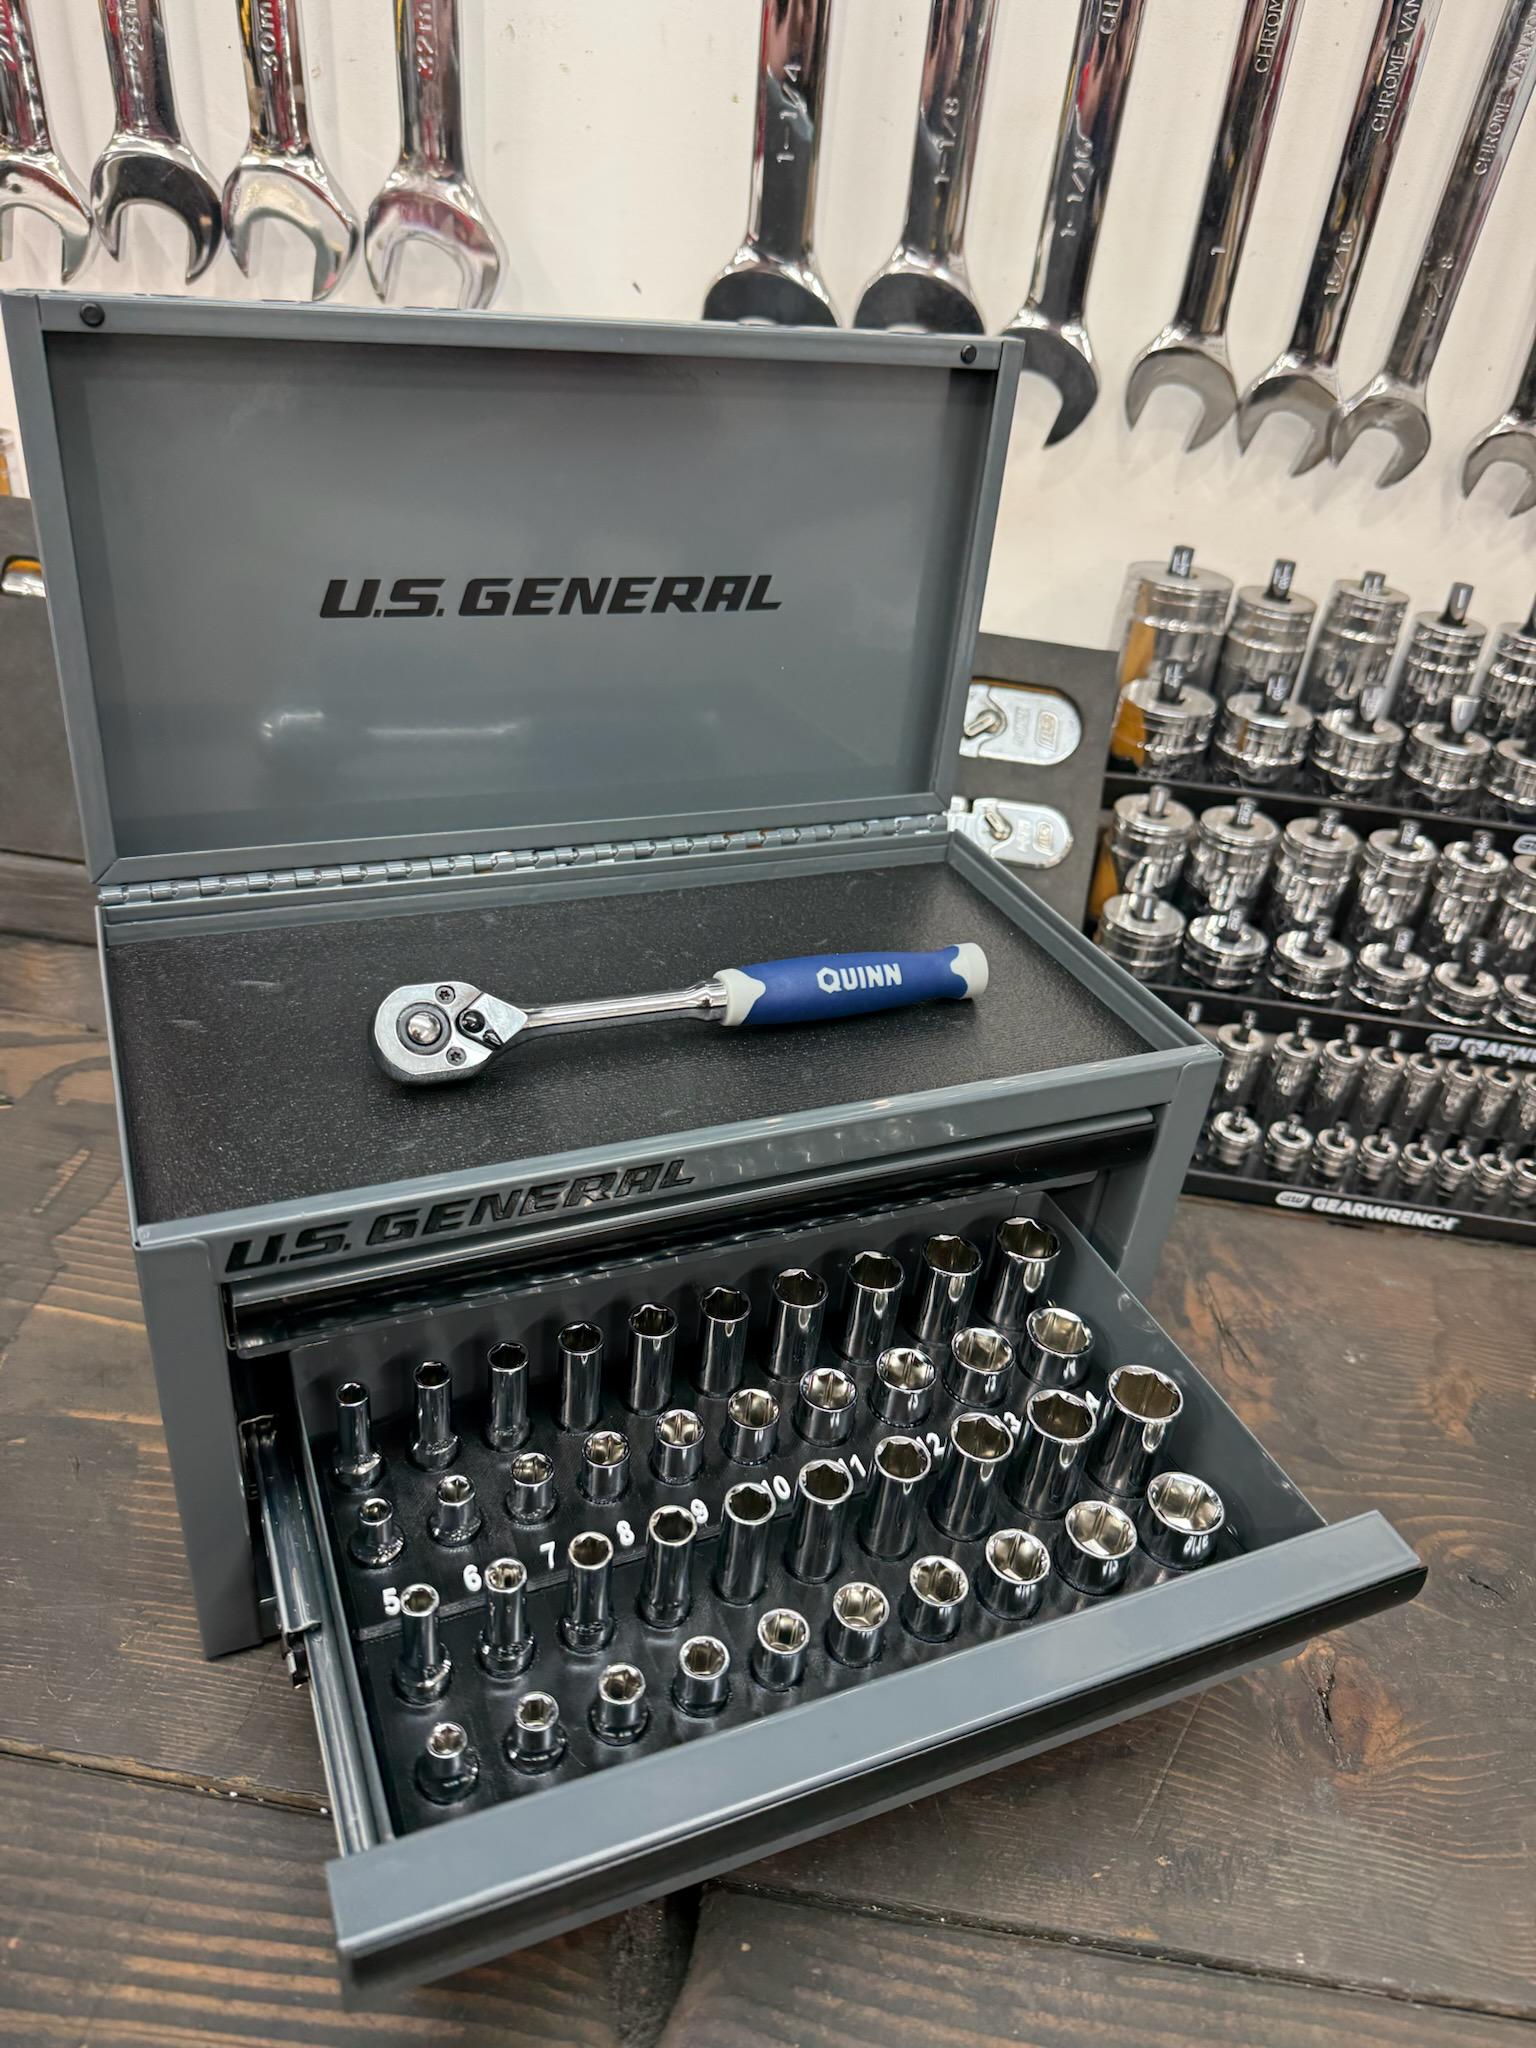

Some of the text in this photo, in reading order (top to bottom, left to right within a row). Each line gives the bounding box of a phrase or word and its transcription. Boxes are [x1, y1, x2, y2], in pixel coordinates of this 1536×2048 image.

[1371, 47, 1407, 132] CHROME
[1473, 92, 1514, 176] CHROME
[320, 574, 783, 619] U.S. GENERAL
[816, 963, 903, 994] QUINN
[225, 1159, 697, 1274] U.S. GENERAL
[1311, 1196, 1461, 1231] GEARWRENCH
[690, 1498, 709, 1524] 9
[616, 1520, 636, 1546] 8
[540, 1541, 556, 1570] 7
[463, 1564, 482, 1592] 6
[382, 1587, 400, 1616] 5
